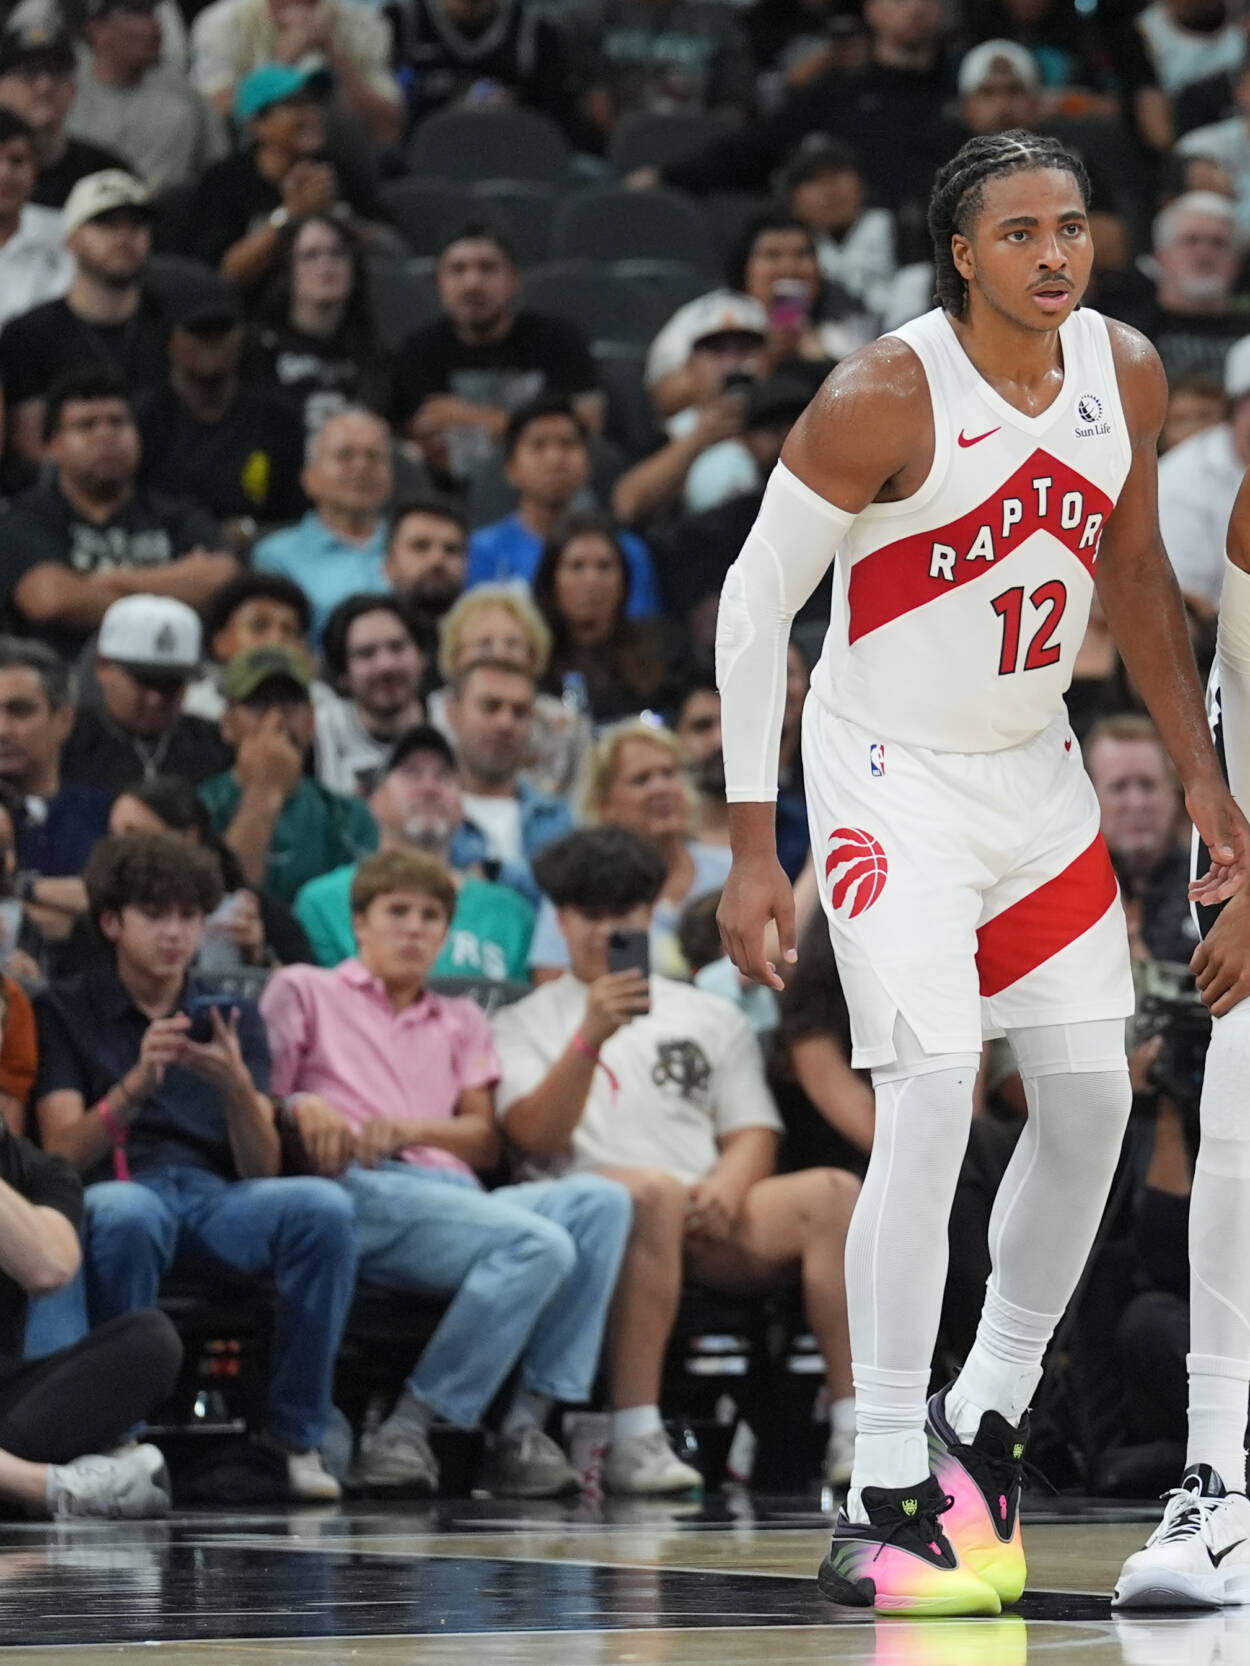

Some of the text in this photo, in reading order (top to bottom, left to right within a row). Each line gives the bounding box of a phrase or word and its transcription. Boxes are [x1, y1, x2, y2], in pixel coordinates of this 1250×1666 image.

[1074, 422, 1111, 439] Sun Life
[929, 476, 1103, 582] RAPTOR
[990, 579, 1067, 675] 12
